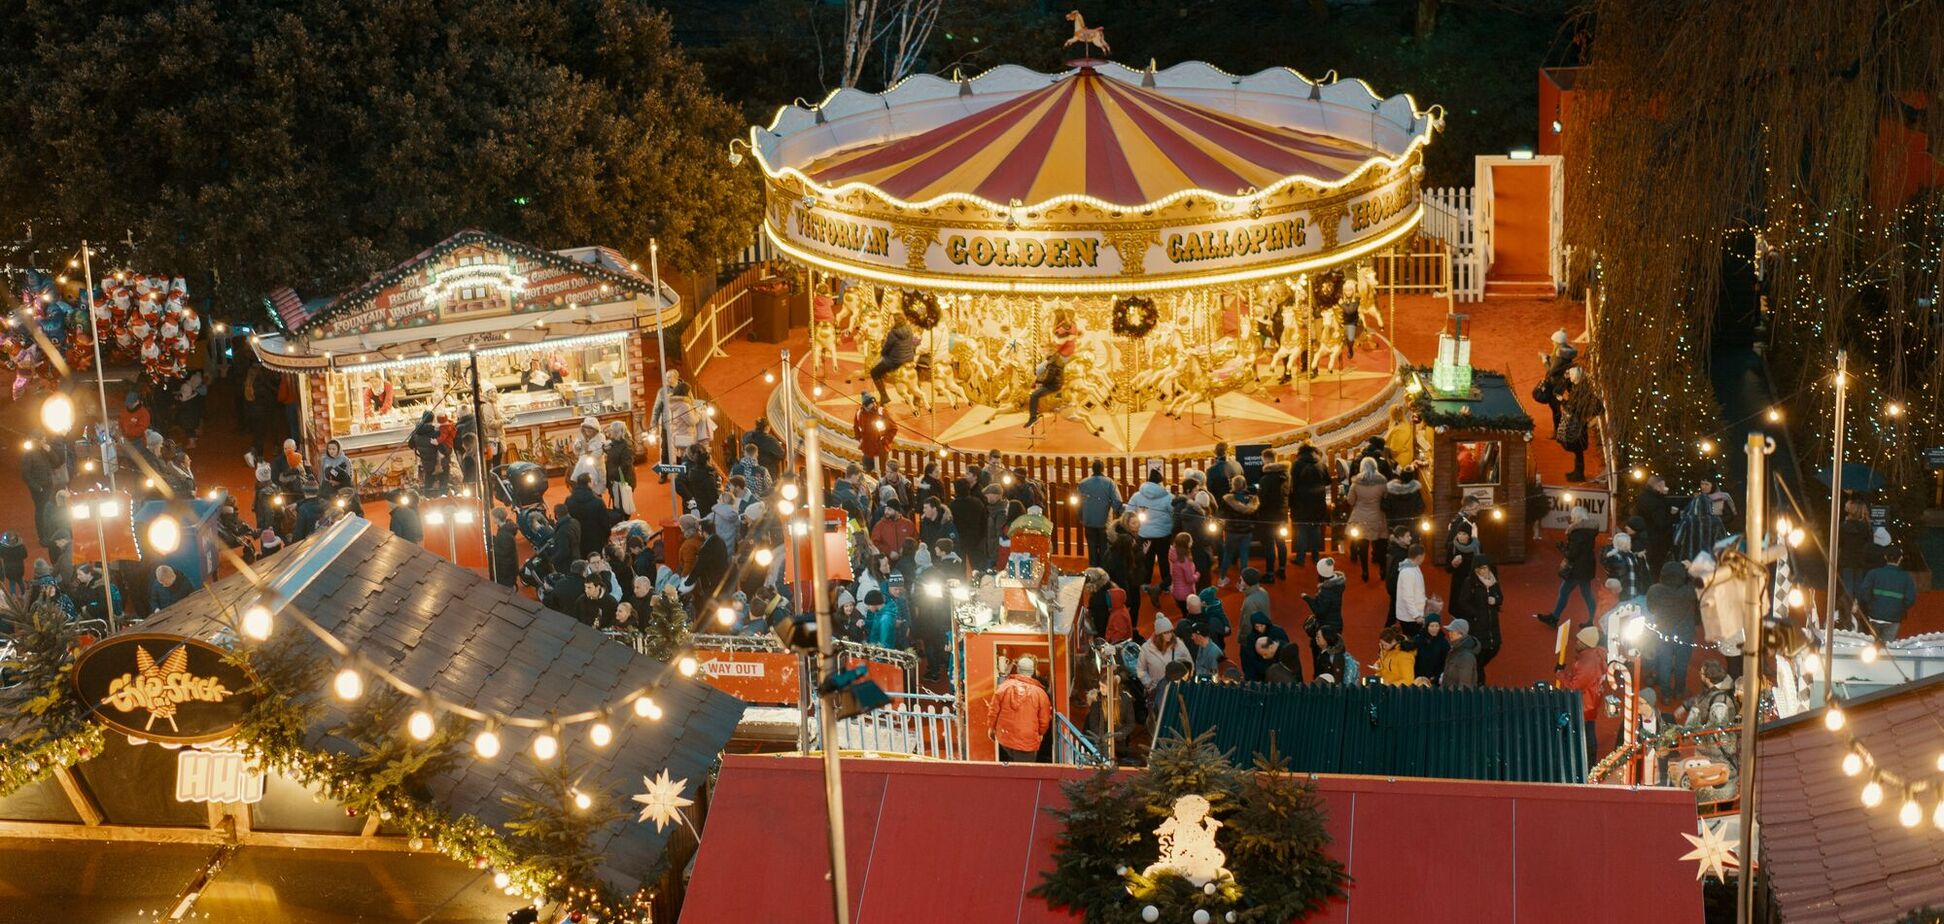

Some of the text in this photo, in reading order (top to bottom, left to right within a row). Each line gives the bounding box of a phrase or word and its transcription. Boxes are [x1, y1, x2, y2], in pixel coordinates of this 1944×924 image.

[795, 206, 889, 257] VICTORIAN
[944, 234, 1099, 268] GOLDEN
[1166, 218, 1307, 263] GALLOPING
[400, 274, 421, 291] HOT
[531, 267, 568, 282] CHOCOLA
[388, 286, 427, 308] BELGI
[524, 287, 541, 301] HOT
[543, 278, 570, 296] FRESH
[565, 288, 599, 304] GROUND
[334, 307, 387, 333] FOUNTAIN
[1575, 497, 1605, 514] ONLY
[708, 663, 757, 675] WAY OUT
[178, 751, 263, 802] HUT
